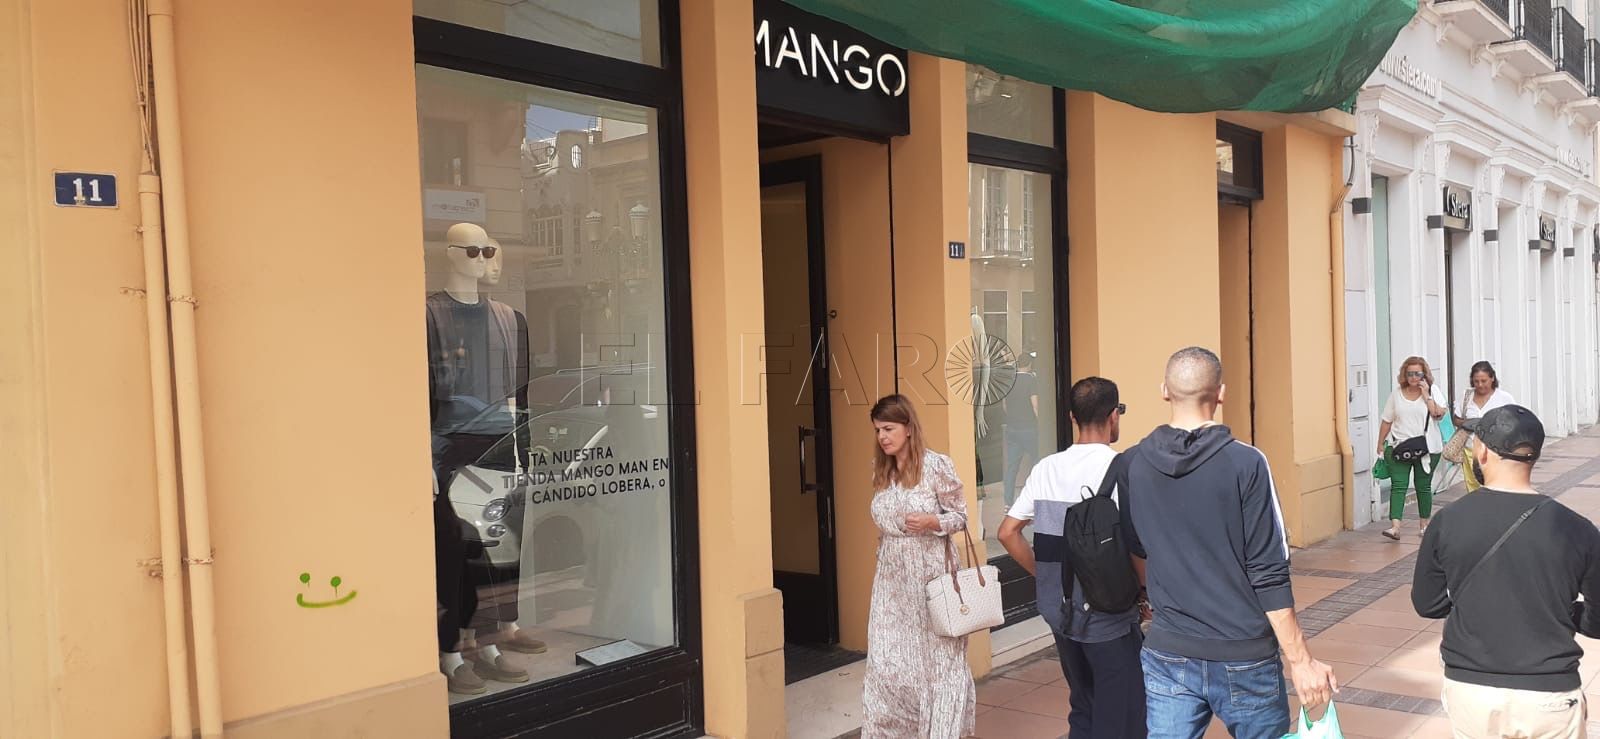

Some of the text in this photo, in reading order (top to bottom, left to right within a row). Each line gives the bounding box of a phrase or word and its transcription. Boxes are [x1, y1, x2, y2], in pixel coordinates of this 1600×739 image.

[756, 19, 906, 97] MANGO
[72, 177, 102, 202] 11
[552, 446, 614, 465] NUESTRA
[501, 457, 669, 489] TIENDA MANGO MAN EN
[532, 484, 597, 504] CÁNDIDO
